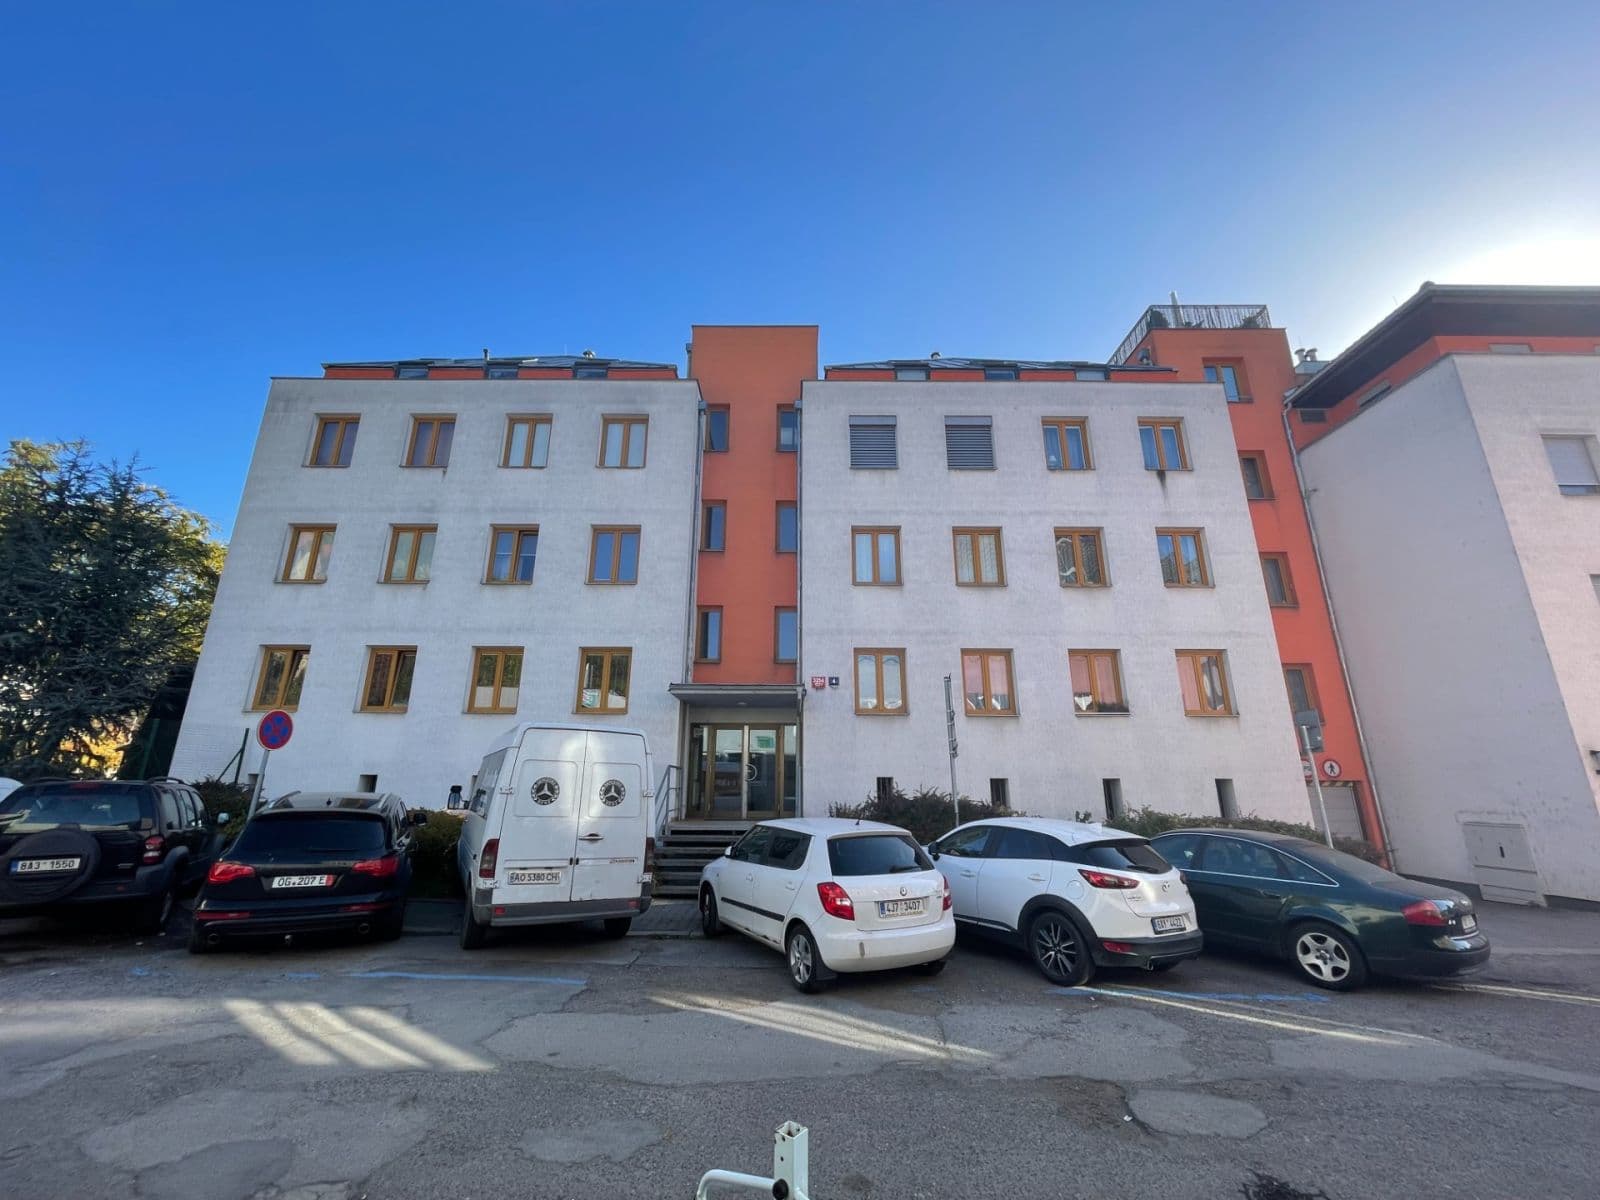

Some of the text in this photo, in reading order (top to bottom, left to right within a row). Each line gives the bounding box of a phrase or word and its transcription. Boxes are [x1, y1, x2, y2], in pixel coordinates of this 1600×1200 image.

[50, 859, 75, 868] 1550
[886, 900, 921, 913] 4J7 3407
